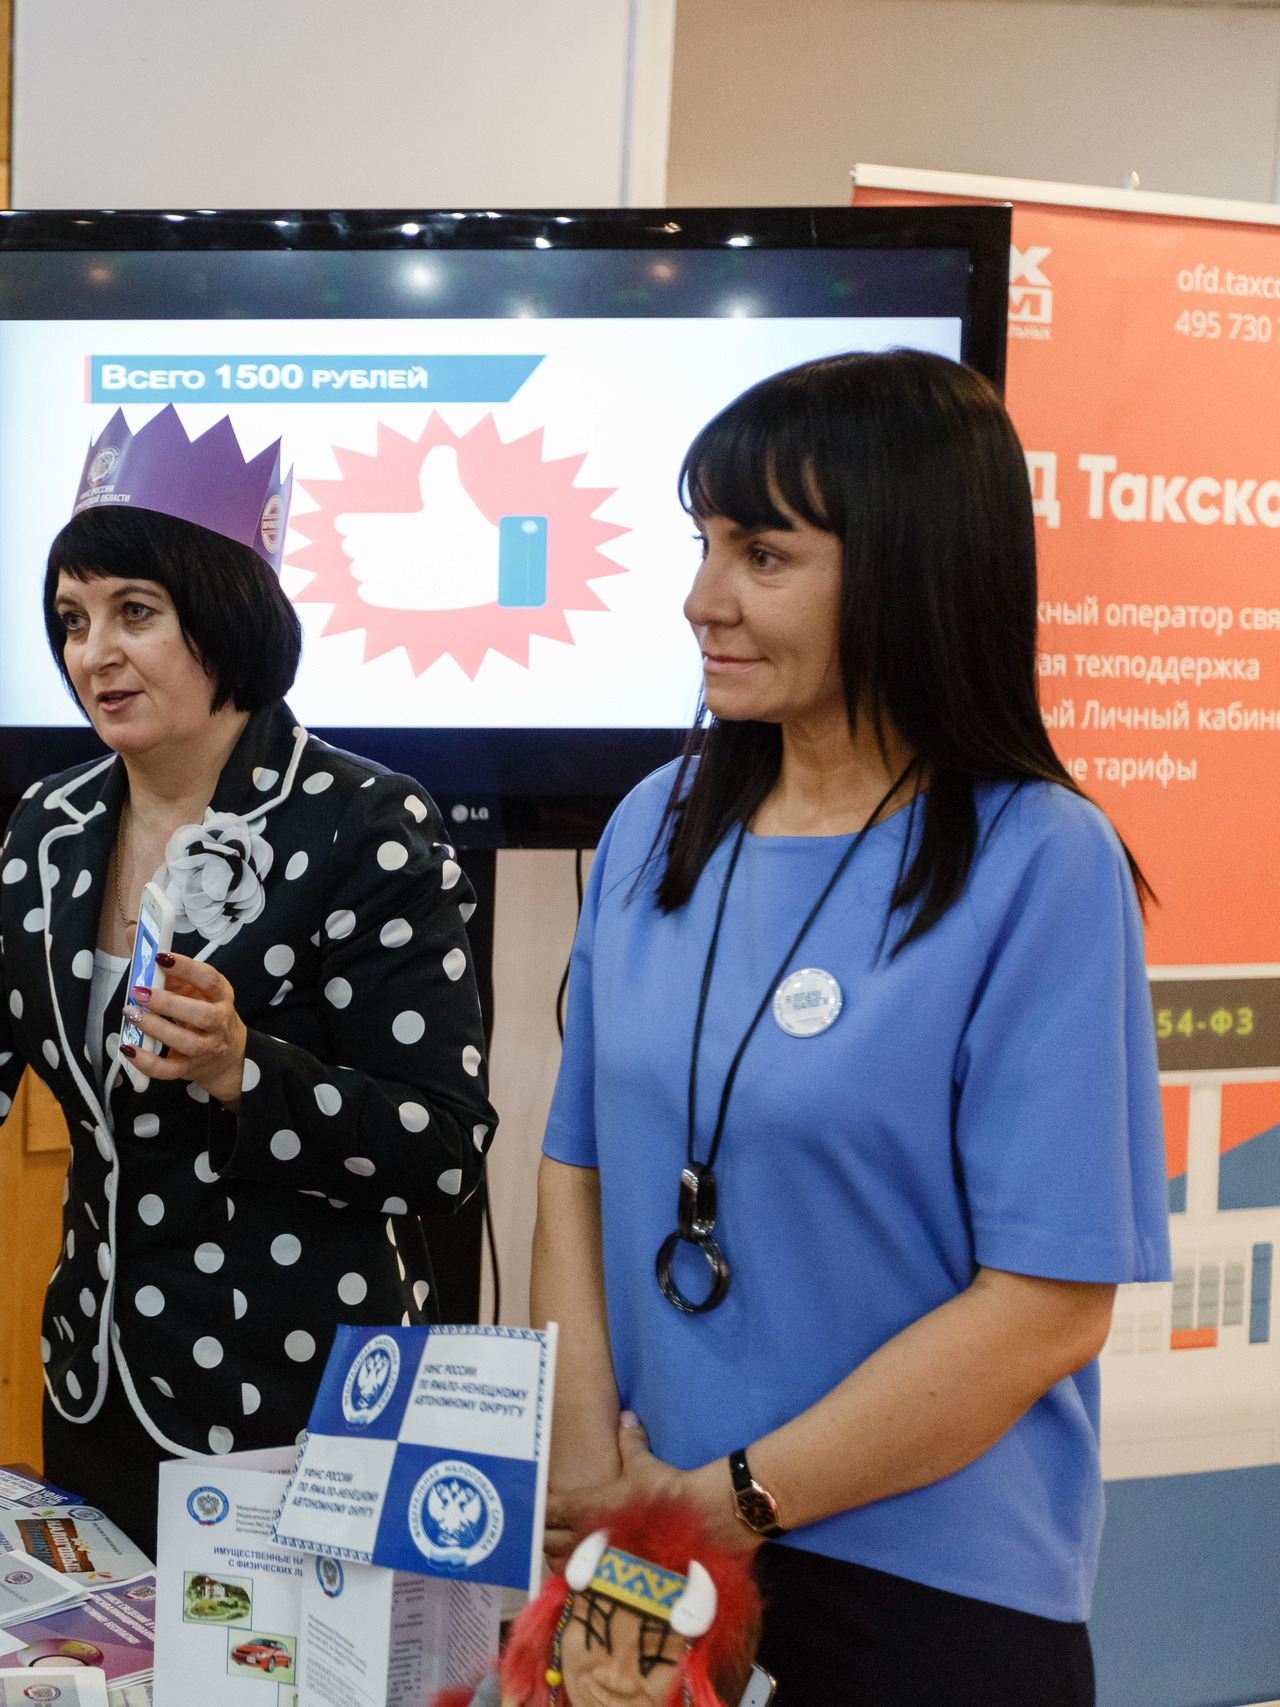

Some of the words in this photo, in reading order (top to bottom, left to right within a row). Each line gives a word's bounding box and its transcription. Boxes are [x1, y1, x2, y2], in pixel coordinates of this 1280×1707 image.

[1175, 308, 1221, 339] 495
[1227, 312, 1272, 343] 730
[215, 363, 304, 391] 1500
[1105, 602, 1234, 638] оператор
[1074, 653, 1261, 688] техподдержка
[1081, 700, 1190, 731] Личный
[1198, 700, 1280, 732] кабин
[1094, 750, 1198, 790] тарифы
[470, 806, 489, 820] LG
[479, 1400, 525, 1418] ОКРУГУ
[45, 1519, 83, 1573] НАЛОГОВЫЕ
[213, 1545, 291, 1565] ИМУЩЕСТВЕННЫЕ
[236, 1560, 292, 1575] ФИЗИЧЕСКИХ
